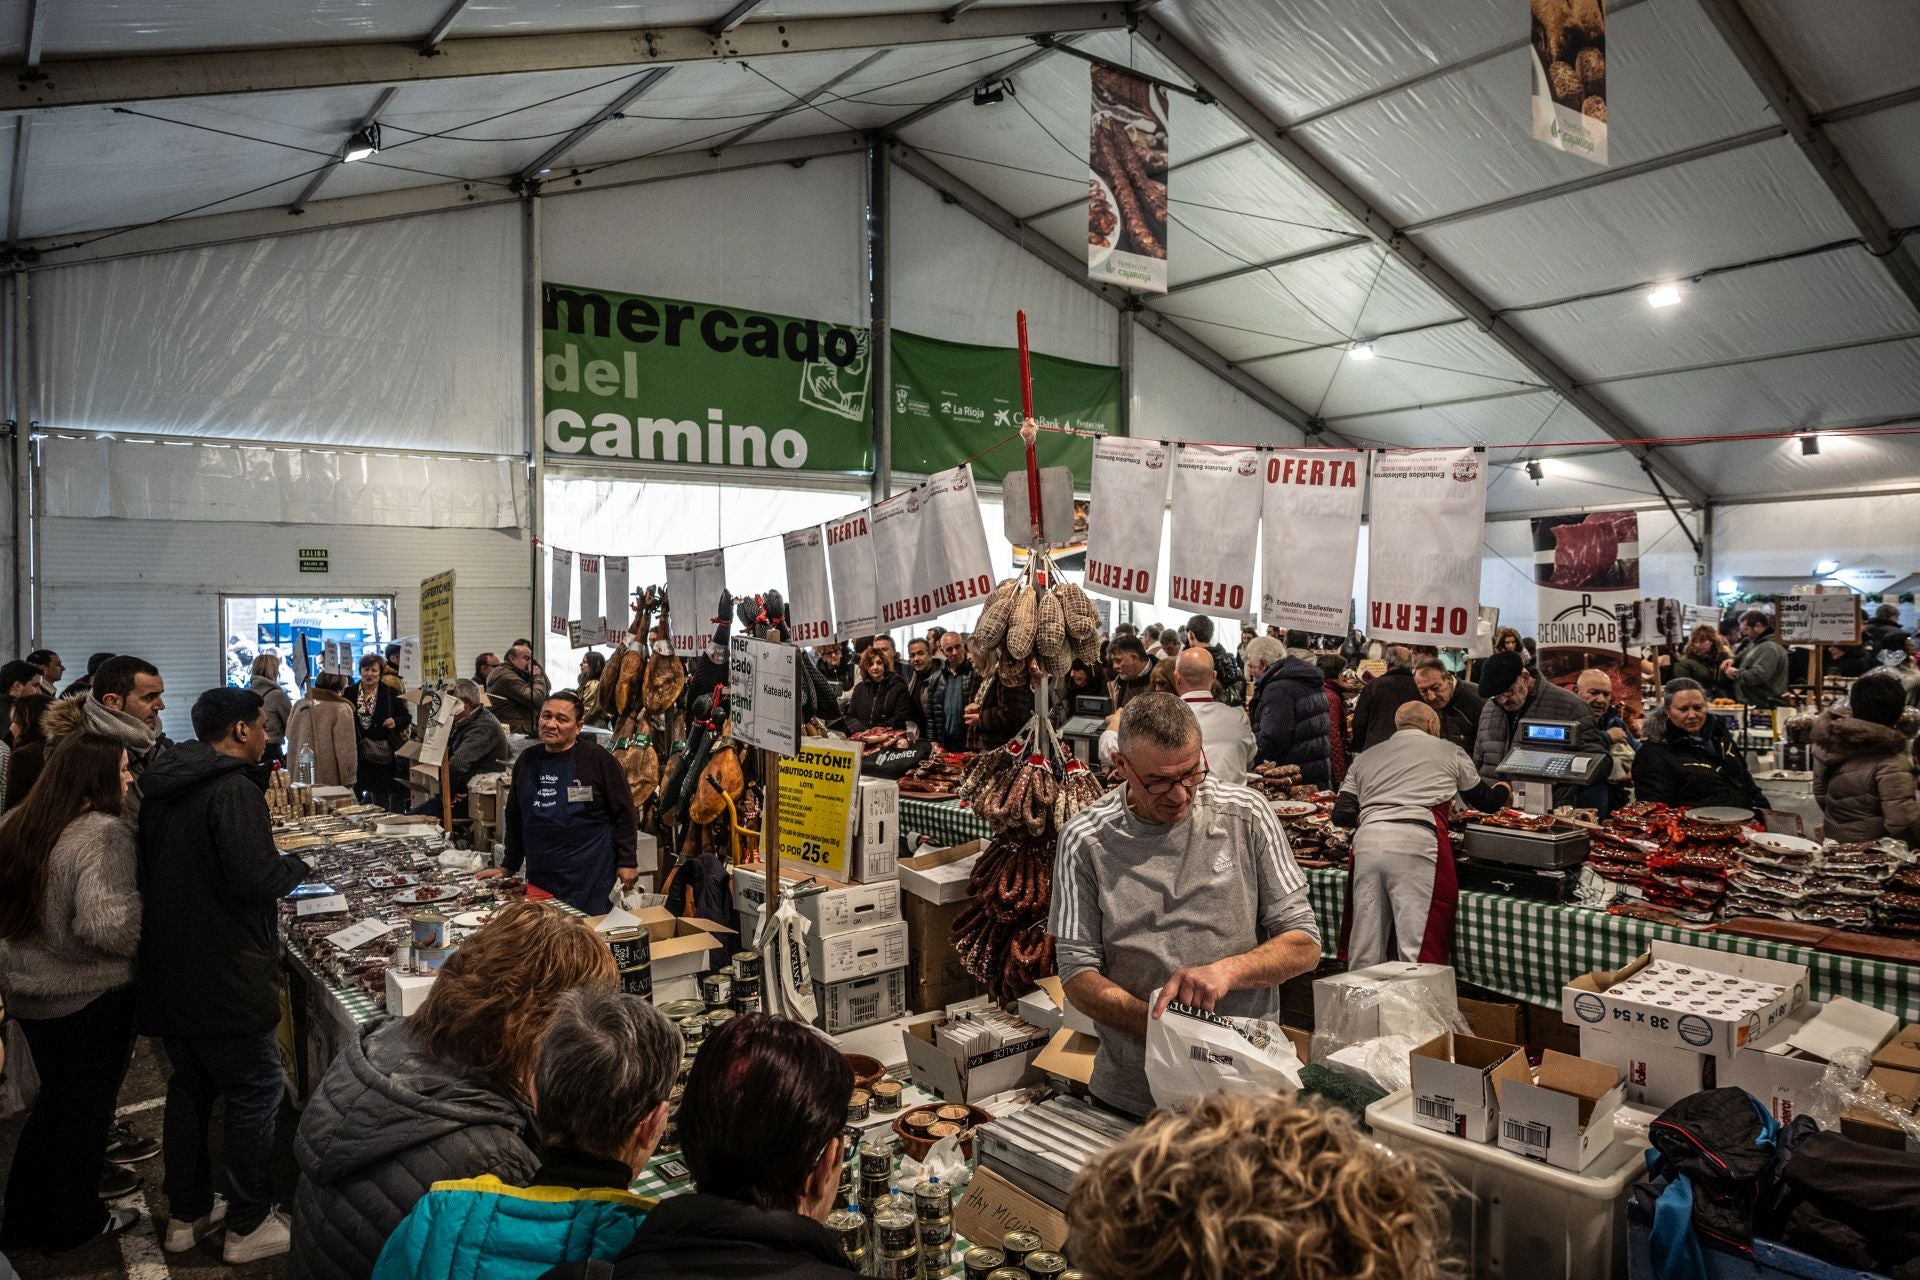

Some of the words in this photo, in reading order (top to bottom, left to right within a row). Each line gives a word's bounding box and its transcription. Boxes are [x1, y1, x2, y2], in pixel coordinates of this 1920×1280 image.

[543, 285, 858, 367] mercado
[544, 343, 638, 399] del
[953, 404, 963, 415] La
[964, 406, 985, 419] Rioja
[544, 408, 808, 468] camino
[1267, 457, 1356, 488] OFERTA
[827, 517, 868, 547] OFERTA
[1089, 559, 1150, 594] OFERTA
[933, 574, 991, 609] OFERTA
[1172, 575, 1244, 610] OFERTA
[882, 594, 931, 624] OFERTA
[1277, 600, 1306, 609] Embutidos
[1308, 603, 1343, 614] Ballesteros
[1372, 601, 1467, 635] OFERTA
[731, 635, 749, 653] mer
[1538, 623, 1585, 644] CECINAS
[1586, 623, 1617, 644] PAB
[731, 657, 751, 675] cado
[786, 655, 792, 664] 12
[731, 692, 752, 712] cami
[764, 684, 792, 699] Katealde
[731, 709, 742, 724] no
[779, 766, 812, 779] MBUTIDOS
[814, 771, 823, 780] DE
[825, 773, 845, 783] CAZA
[786, 844, 801, 857] POR
[801, 842, 821, 863] 25
[822, 851, 830, 864] €
[1613, 1007, 1632, 1022] 54
[1636, 1012, 1645, 1022] x
[1650, 1015, 1669, 1030] 38
[965, 1186, 990, 1215] HAY
